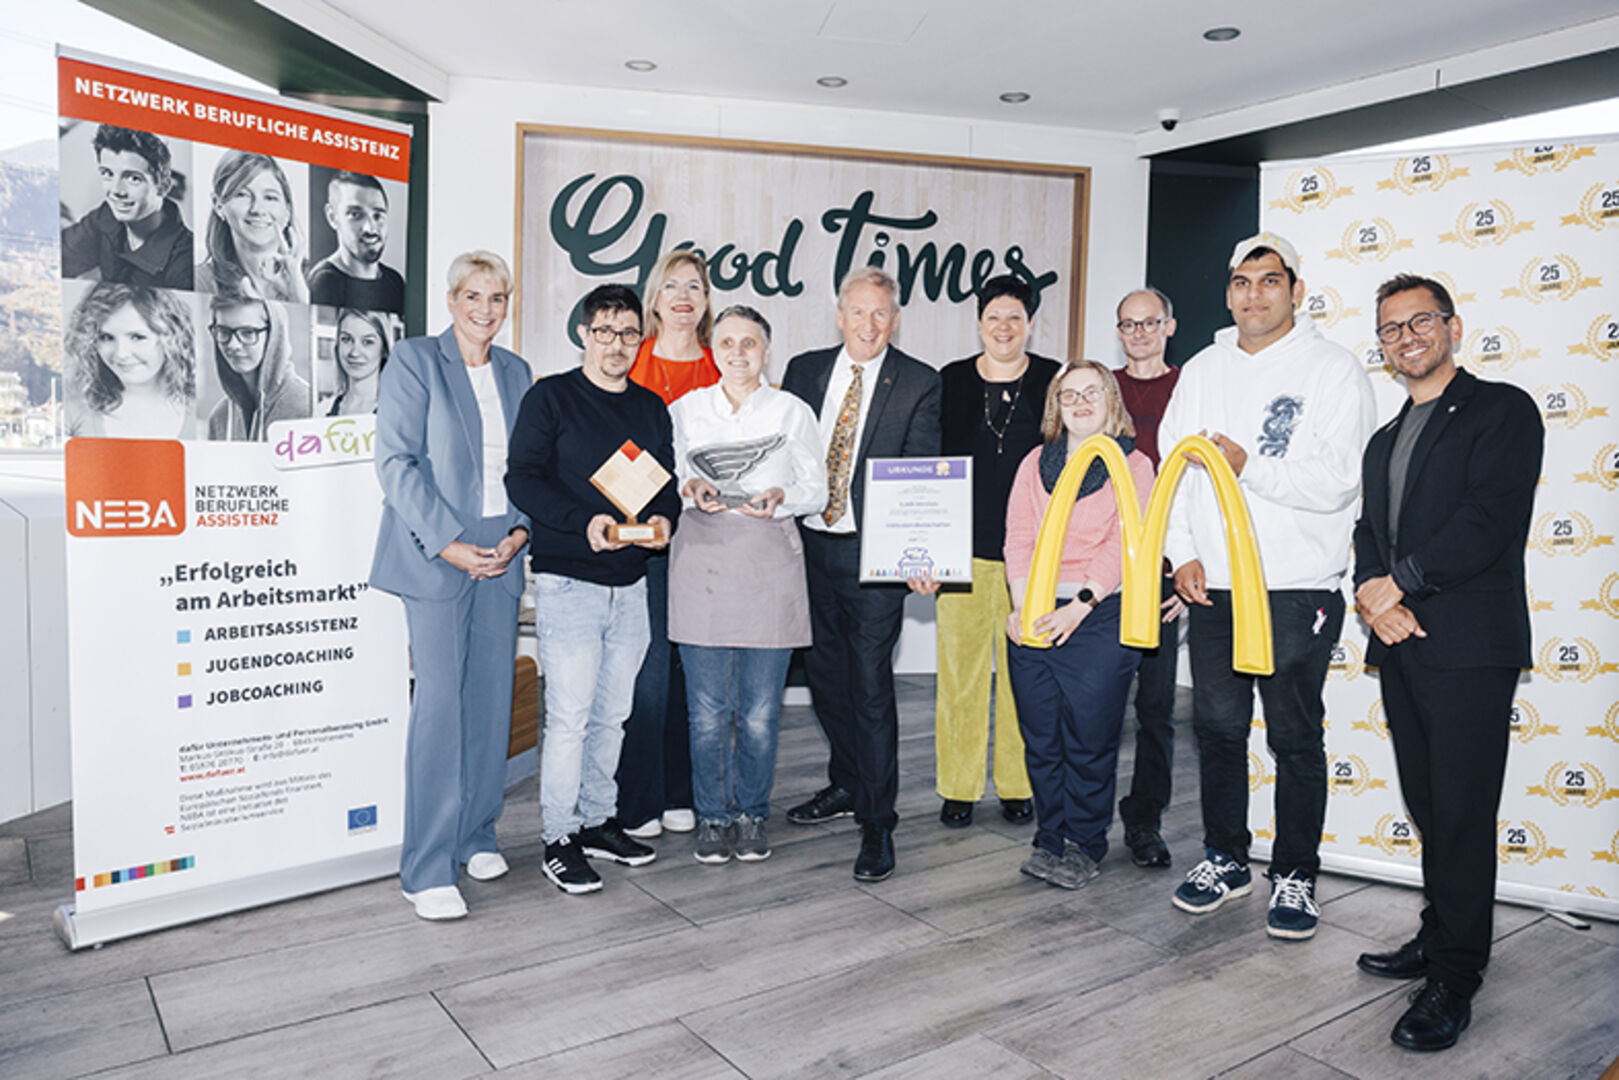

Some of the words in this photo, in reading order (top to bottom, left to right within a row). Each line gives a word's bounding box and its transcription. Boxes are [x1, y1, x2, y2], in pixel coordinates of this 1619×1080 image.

[74, 77, 189, 116] NETZWERK
[194, 102, 308, 141] BERUFLICHE
[312, 128, 400, 160] ASSISTENZ
[1413, 156, 1431, 173] 25
[1301, 175, 1319, 192] 25
[1475, 209, 1495, 227] 25
[1359, 227, 1377, 243] 25
[821, 190, 1058, 307] Times
[1540, 264, 1560, 281] 25
[1308, 295, 1326, 311] 25
[1607, 322, 1619, 339] 2
[1482, 335, 1501, 352] 25
[1546, 393, 1566, 409] 25
[274, 419, 377, 461] dafür
[888, 464, 933, 475] URKUNDE
[195, 485, 279, 499] NETZWERK
[195, 499, 289, 513] BERUFLICHE
[75, 500, 177, 529] NEBA
[196, 514, 279, 528] ASSISTENZ
[1553, 520, 1573, 536] 25
[176, 596, 212, 612] am
[204, 617, 359, 641] ARBEITSASSISTENZ
[206, 646, 355, 674] JUGENDCOACHING
[1559, 646, 1580, 662] 25
[206, 680, 324, 706] JOBCOACHING
[1510, 707, 1520, 723] 5
[1335, 763, 1352, 776] 25
[1565, 771, 1585, 786] 25
[1392, 823, 1410, 837] 25
[1507, 829, 1527, 844] 25
